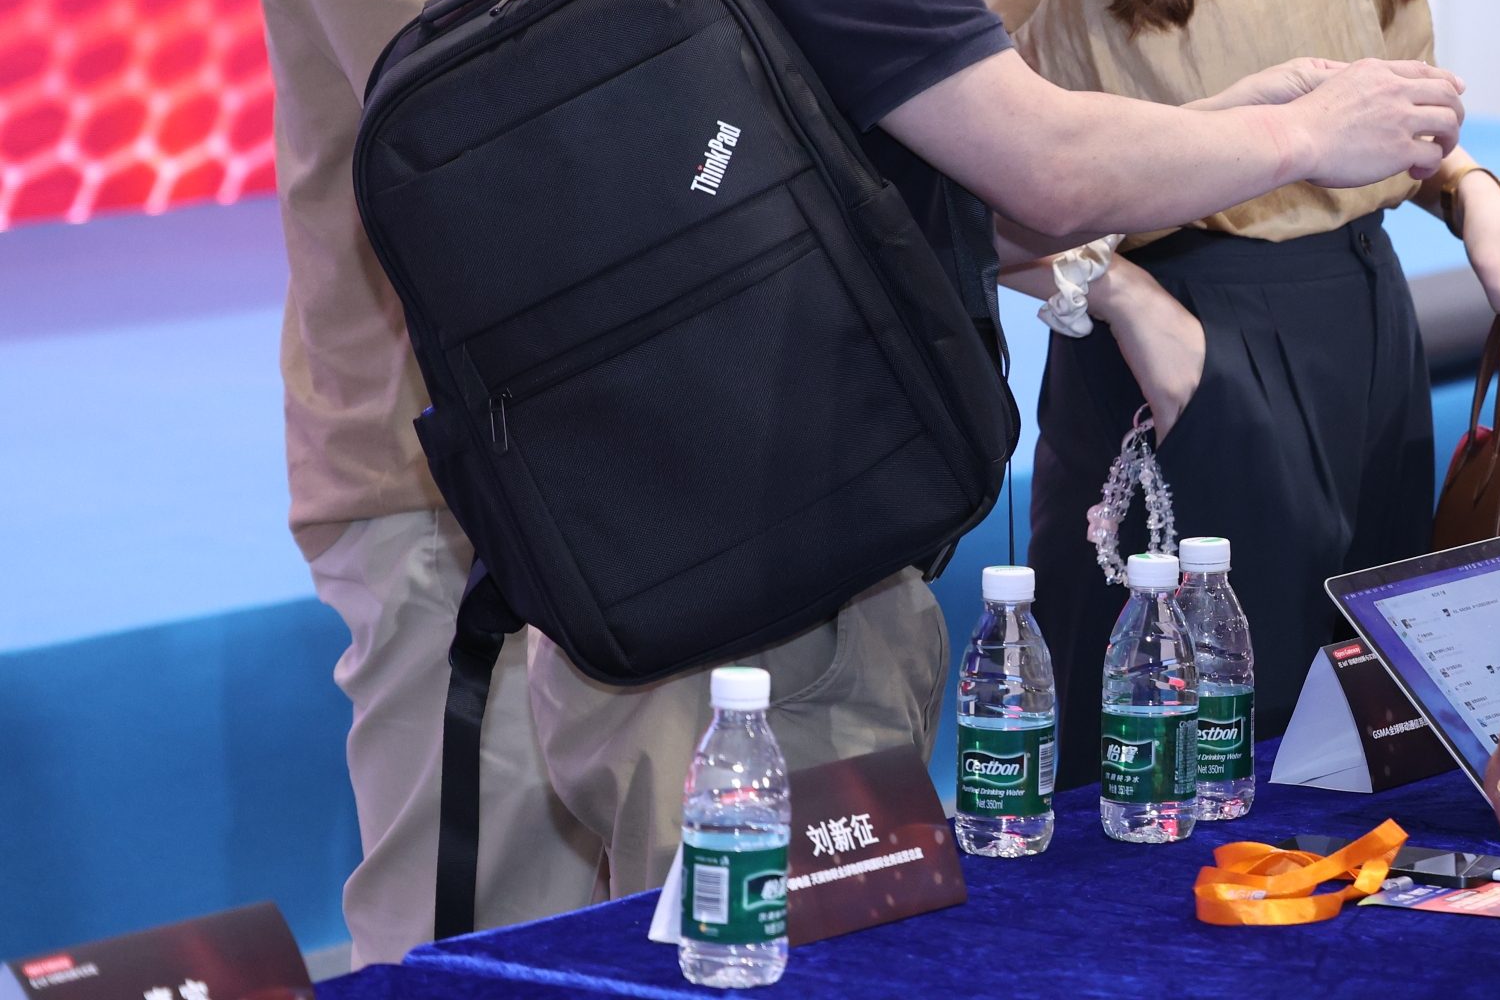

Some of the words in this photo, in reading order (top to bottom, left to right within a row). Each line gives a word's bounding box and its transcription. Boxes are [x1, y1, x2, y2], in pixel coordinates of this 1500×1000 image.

[690, 120, 742, 196] ThinkPad
[1197, 726, 1238, 741] estbon
[965, 758, 1020, 776] Cestbon
[980, 787, 1006, 798] Drinking
[1005, 788, 1026, 797] Water
[986, 799, 1004, 810] 350ml
[805, 813, 880, 857] 刘新征
